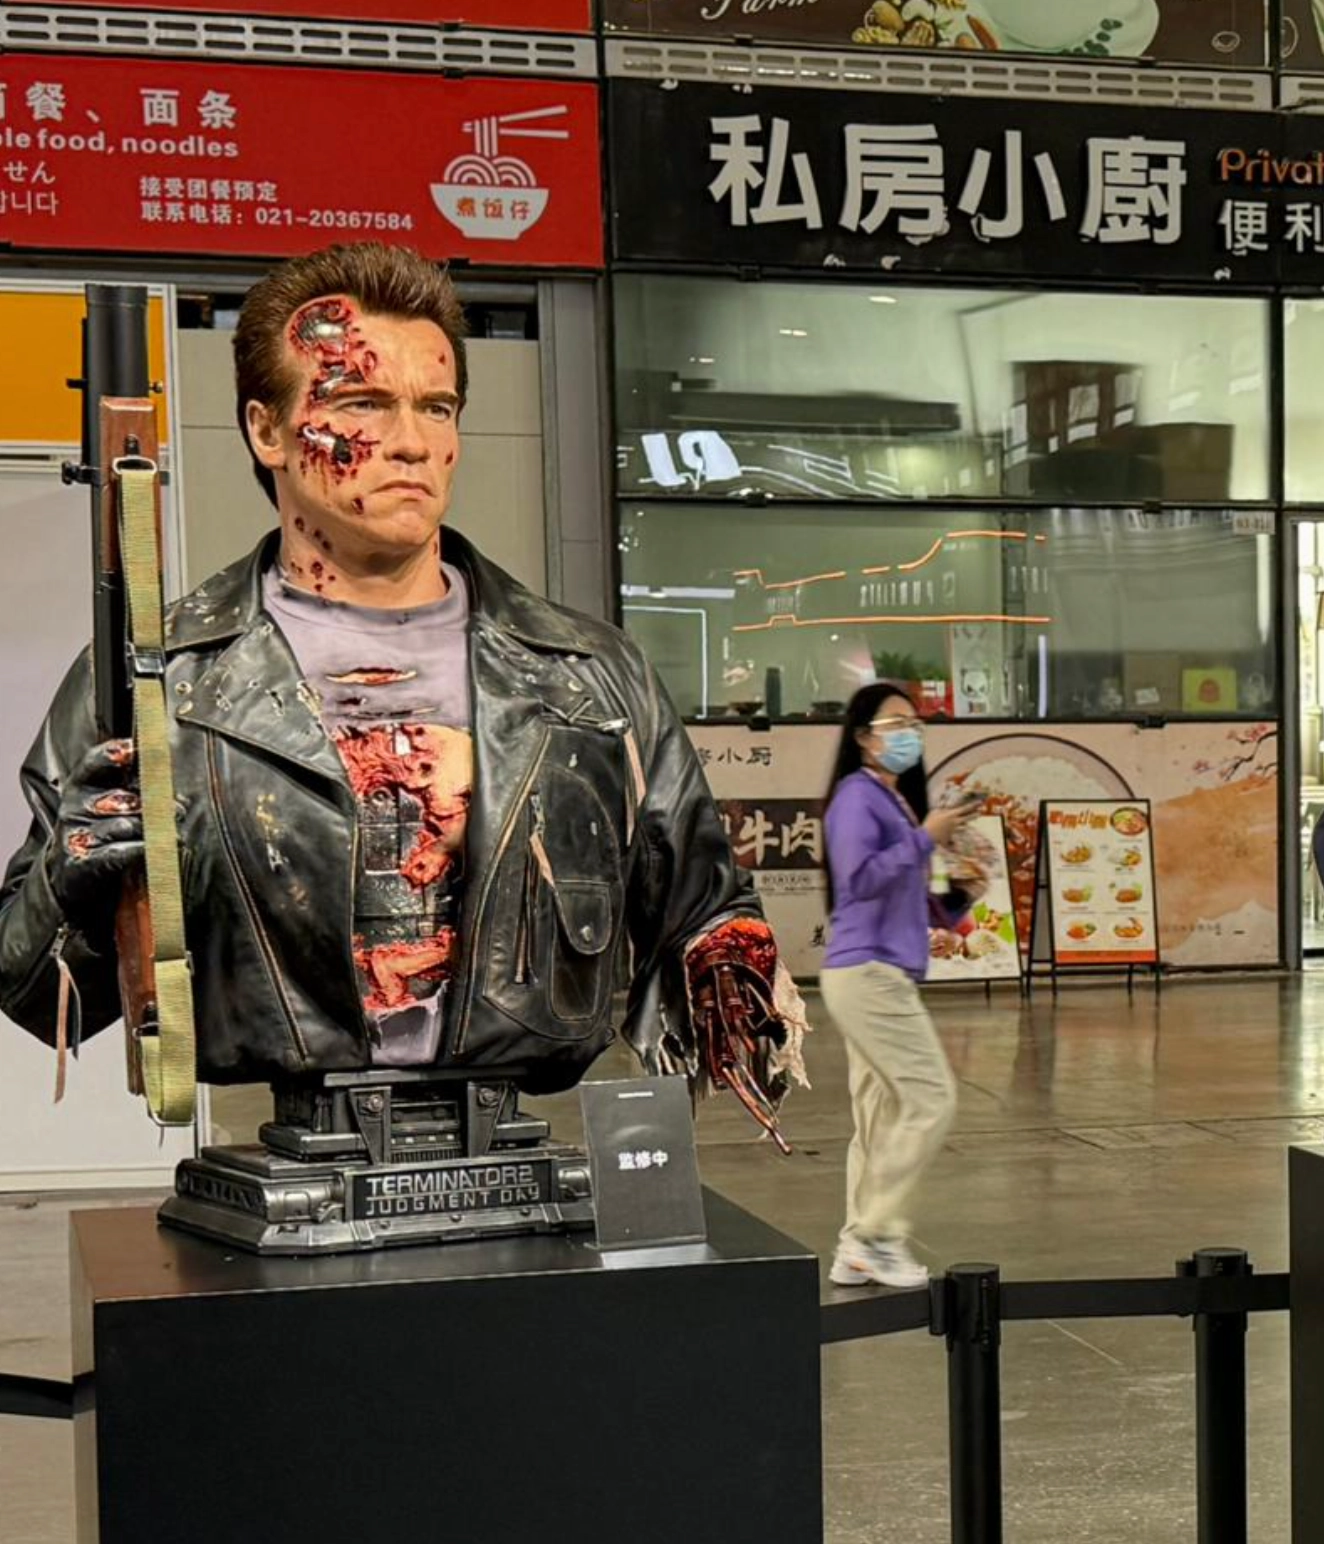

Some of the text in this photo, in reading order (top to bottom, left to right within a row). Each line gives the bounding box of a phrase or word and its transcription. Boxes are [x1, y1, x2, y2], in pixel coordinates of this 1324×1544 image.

[37, 128, 114, 155] food,
[122, 136, 239, 158] noodles
[708, 113, 1188, 246] 私房小廚
[0, 190, 60, 216] 니다
[366, 1191, 491, 1216] JUDGMENT
